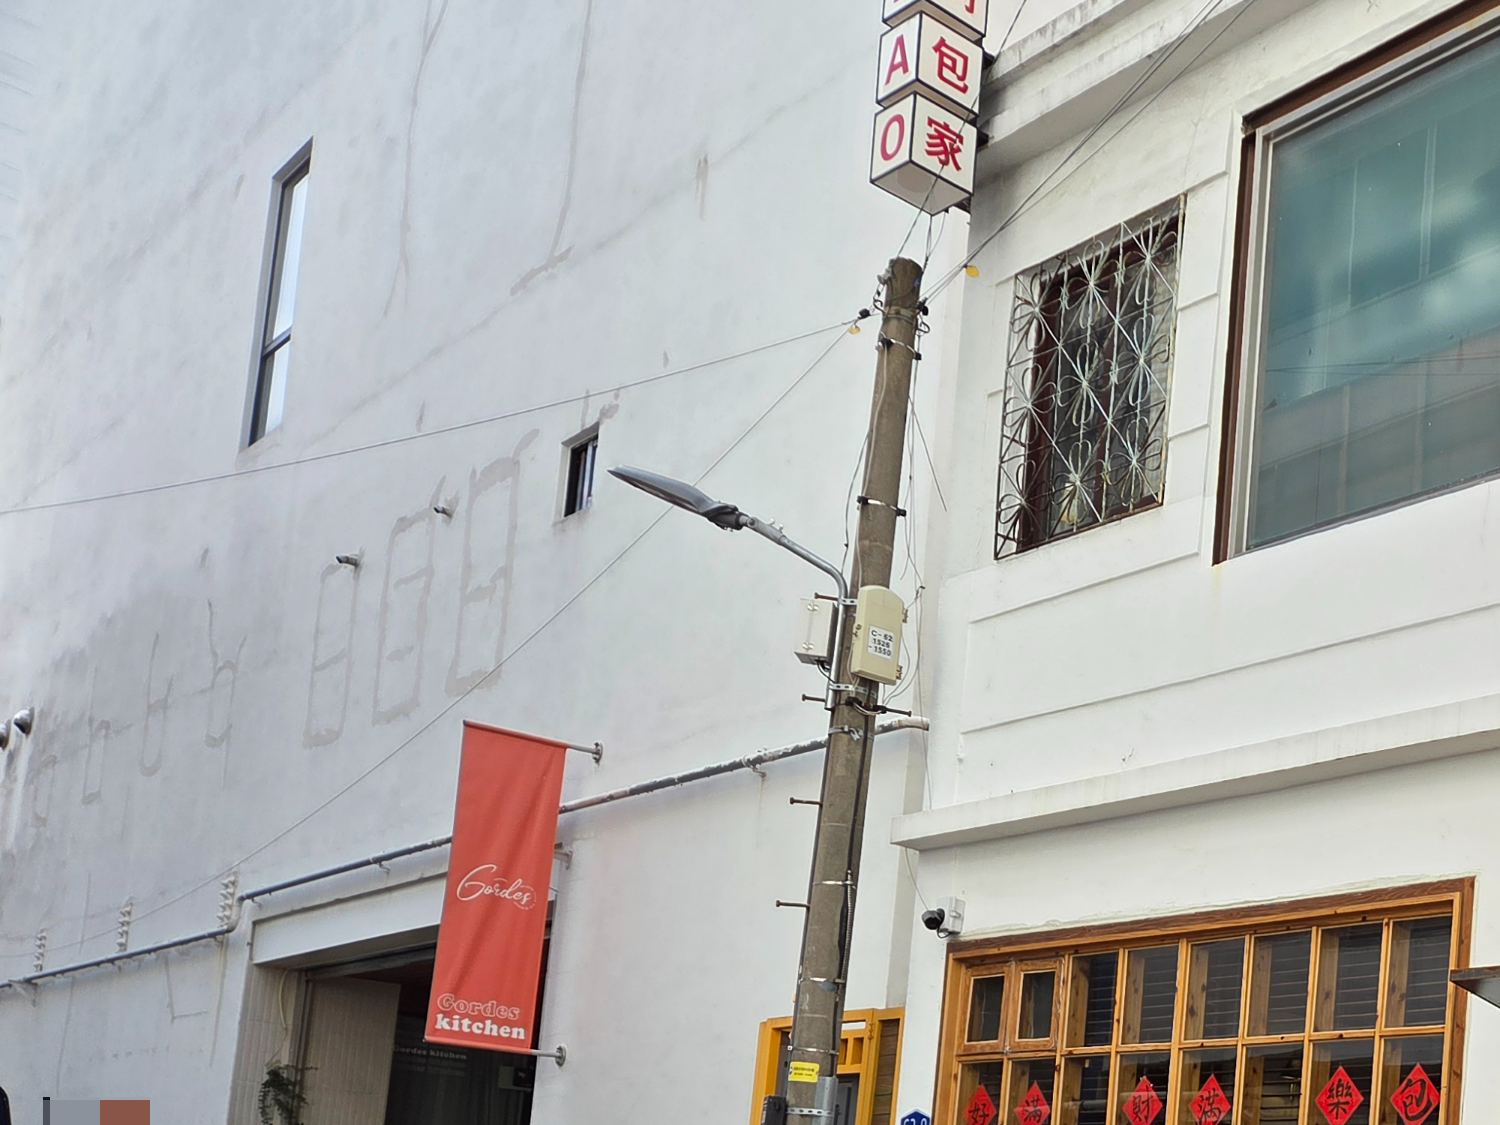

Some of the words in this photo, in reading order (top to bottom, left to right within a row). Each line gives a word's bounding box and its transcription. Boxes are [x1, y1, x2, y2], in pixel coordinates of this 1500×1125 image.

[456, 863, 532, 902] Gordes
[434, 1013, 526, 1040] kitchen
[436, 993, 520, 1021] Gordes
[1326, 1078, 1353, 1120] 樂
[1400, 1078, 1433, 1122] 包
